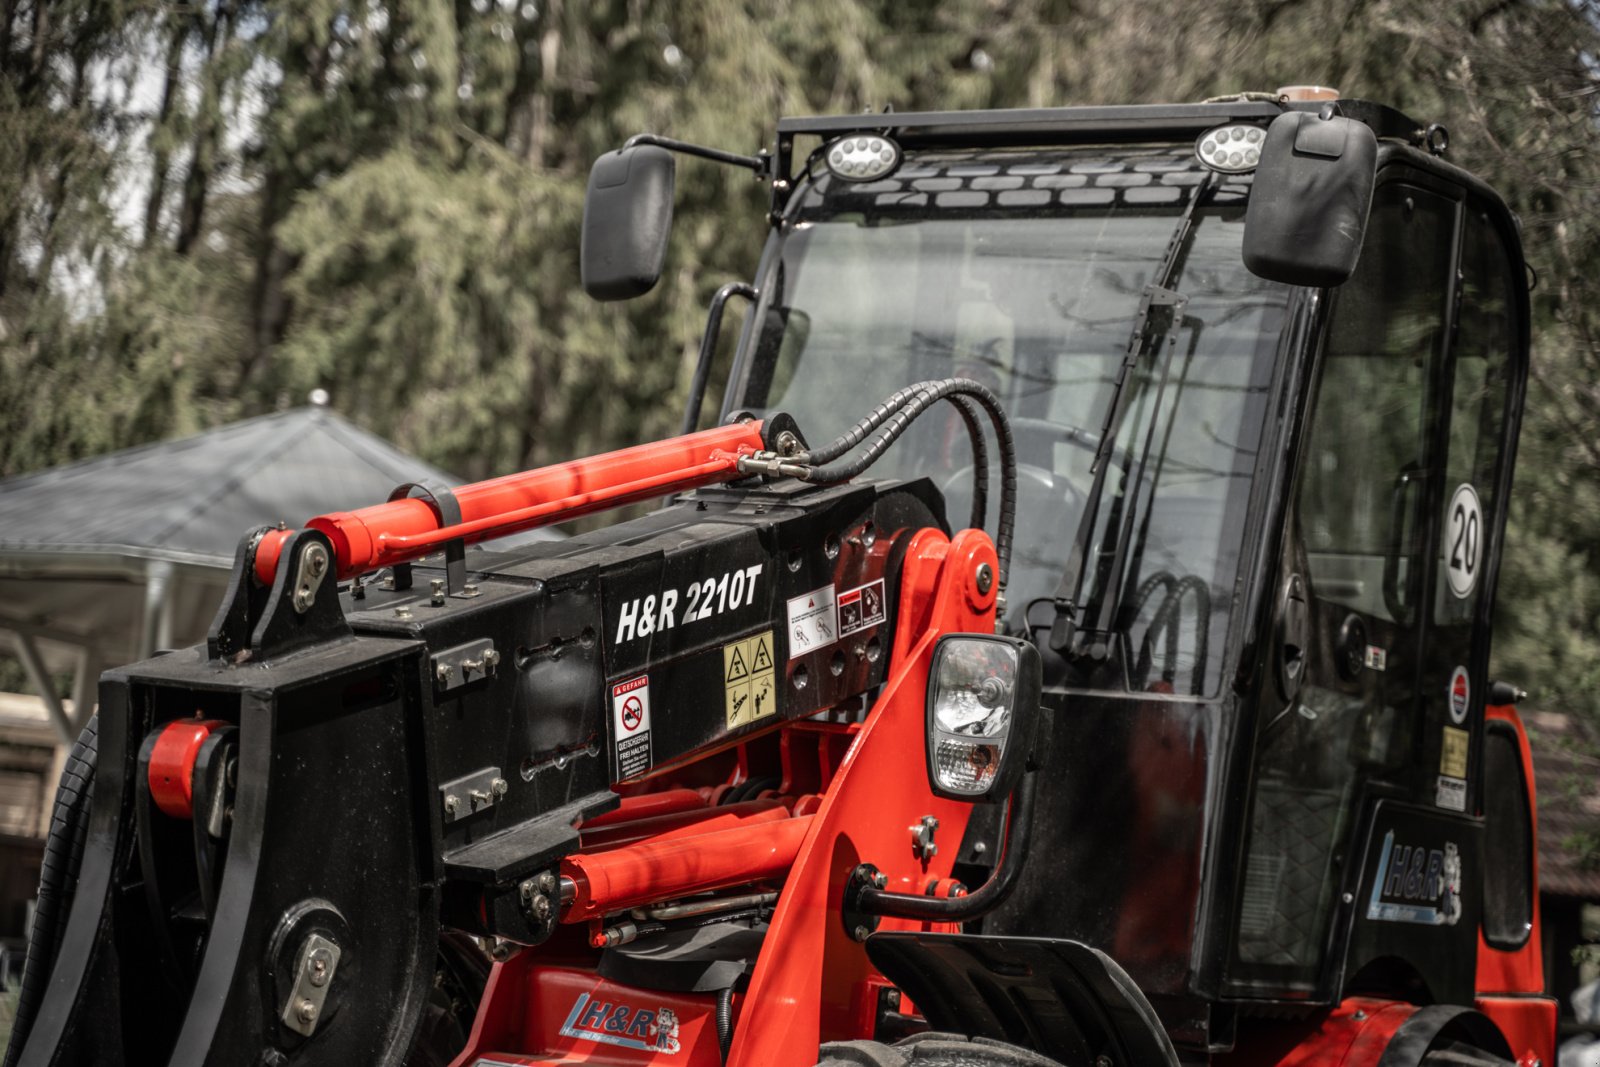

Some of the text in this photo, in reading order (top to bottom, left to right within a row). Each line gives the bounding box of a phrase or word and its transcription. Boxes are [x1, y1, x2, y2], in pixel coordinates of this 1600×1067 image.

[1450, 503, 1478, 575] 20
[615, 563, 763, 645] H&R 2210T
[622, 678, 646, 691] GEFAHR
[619, 750, 631, 761] FREI
[630, 743, 649, 756] HALTEN
[1383, 844, 1443, 902] H&R
[579, 1000, 655, 1038] H&R
